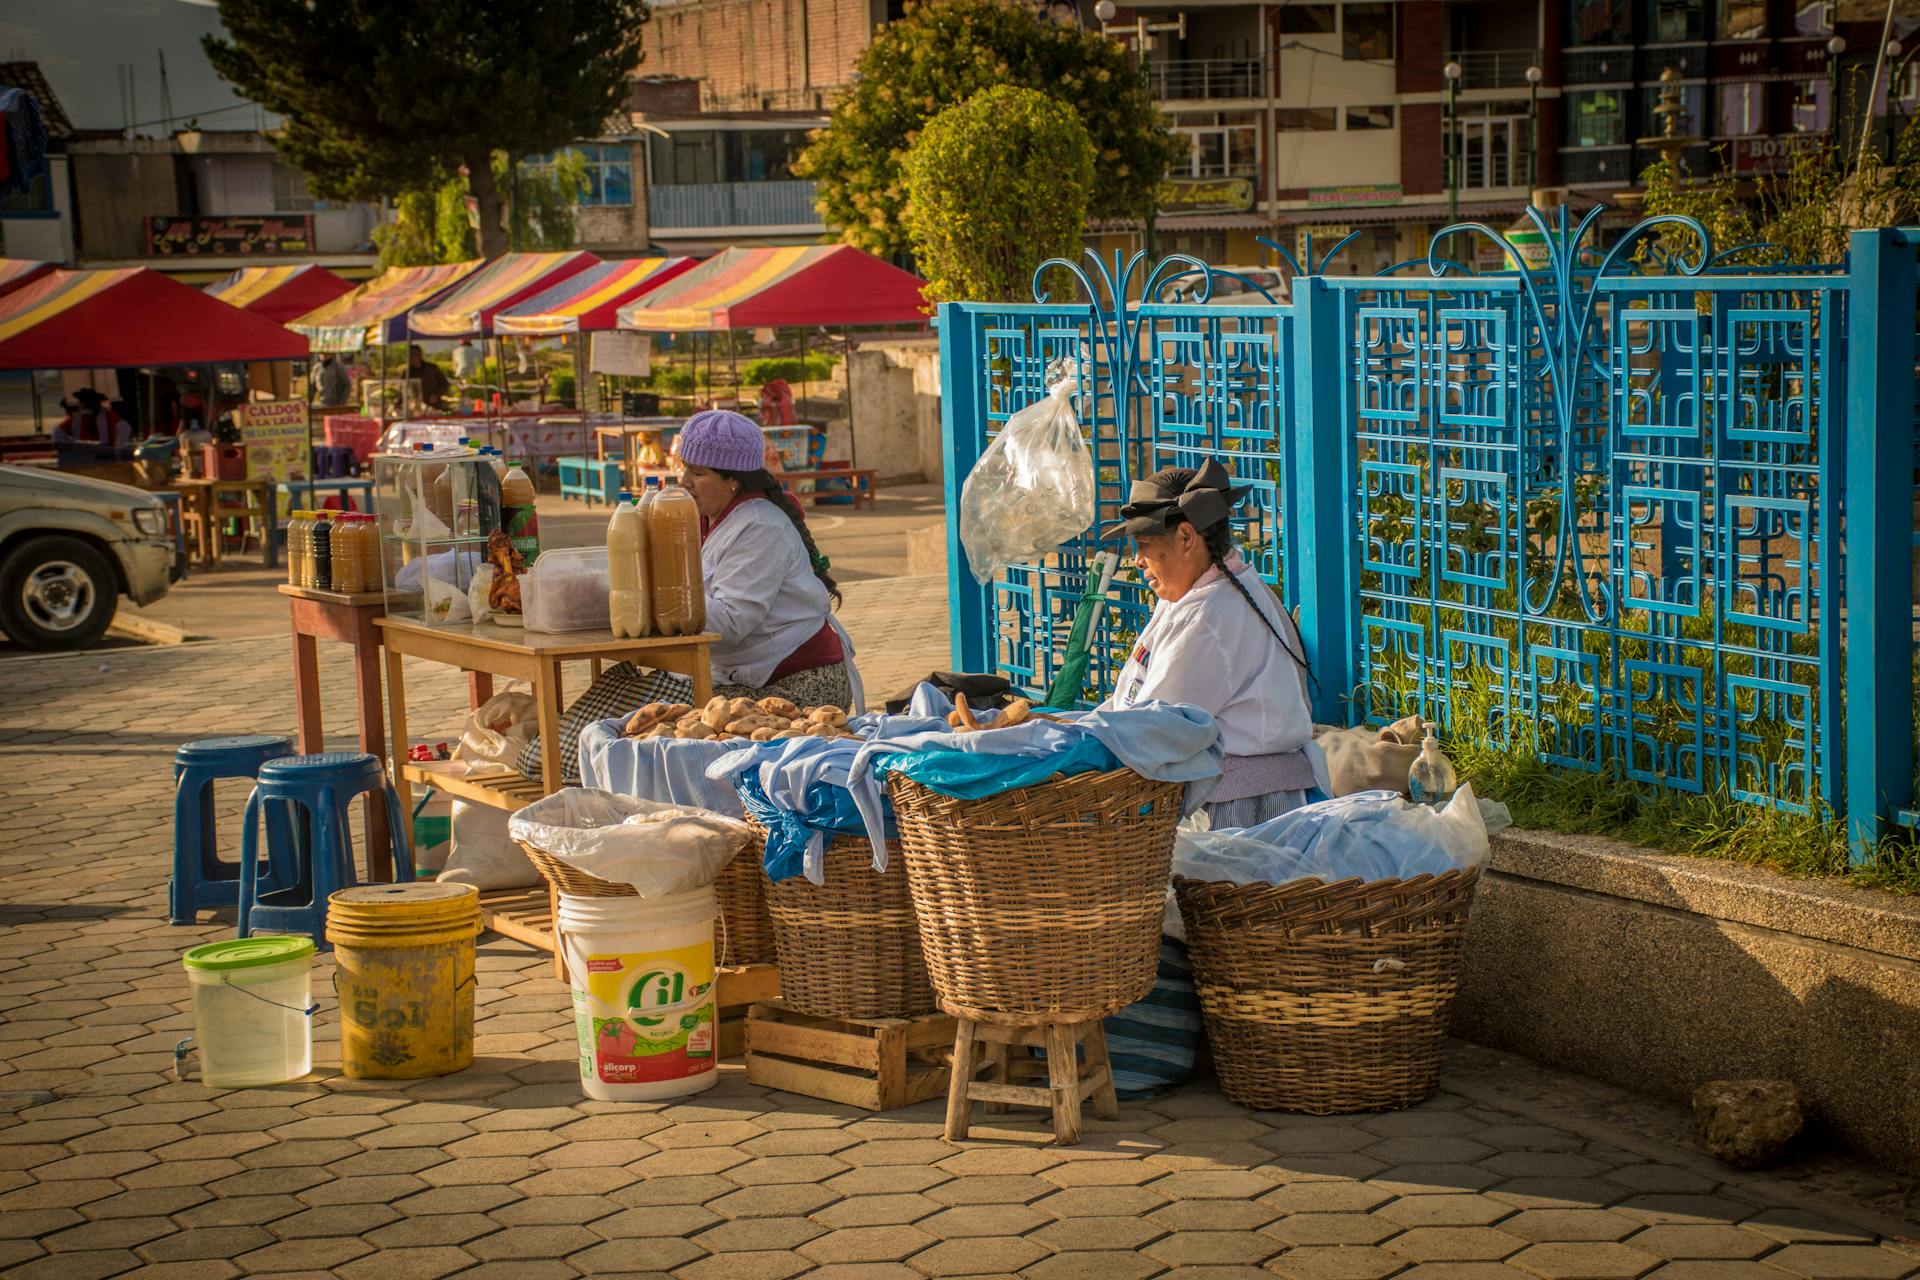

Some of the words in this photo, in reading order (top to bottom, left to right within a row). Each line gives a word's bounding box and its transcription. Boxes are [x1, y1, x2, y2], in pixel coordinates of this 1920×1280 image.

[1312, 226, 1348, 236] HOTEL
[249, 403, 301, 417] CALDOS
[256, 418, 271, 427] LA
